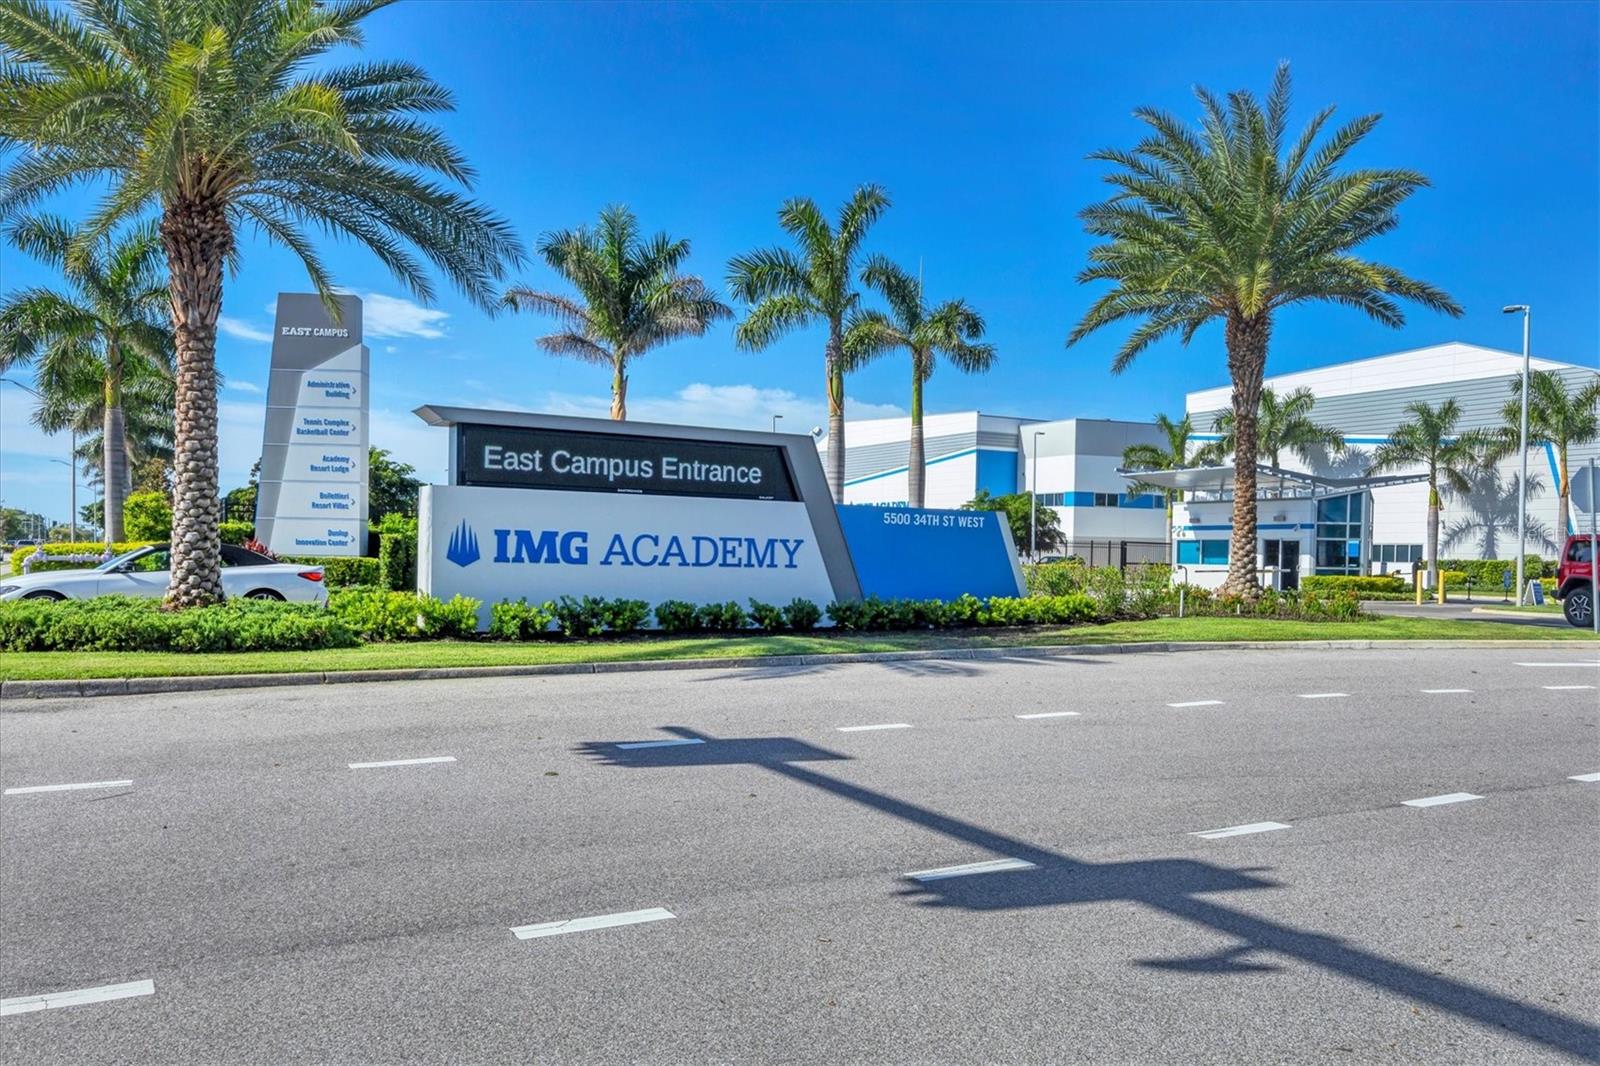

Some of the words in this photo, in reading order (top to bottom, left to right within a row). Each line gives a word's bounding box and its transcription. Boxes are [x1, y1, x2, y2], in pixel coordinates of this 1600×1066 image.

[281, 326, 312, 336] EAST
[313, 327, 349, 337] CAMPUS
[307, 380, 350, 389] Administrative
[325, 390, 350, 400] Building
[303, 418, 323, 426] Tennis
[324, 418, 350, 427] Complex
[296, 428, 328, 436] Basketball
[329, 428, 350, 437] Center
[322, 455, 350, 463] Academy
[331, 465, 350, 474] Lodge
[483, 445, 543, 473] East
[550, 449, 654, 481] Campus
[661, 456, 763, 485] Entrance
[333, 502, 349, 510] Villas
[883, 512, 911, 525] 5500
[913, 514, 940, 526] 34TH
[942, 515, 954, 527] ST
[958, 516, 985, 528] WEST
[327, 529, 349, 537] Dunlop
[295, 538, 327, 546] Innovation
[328, 539, 349, 547] Center
[494, 529, 589, 565] IMG
[600, 533, 805, 569] ACADEMY
